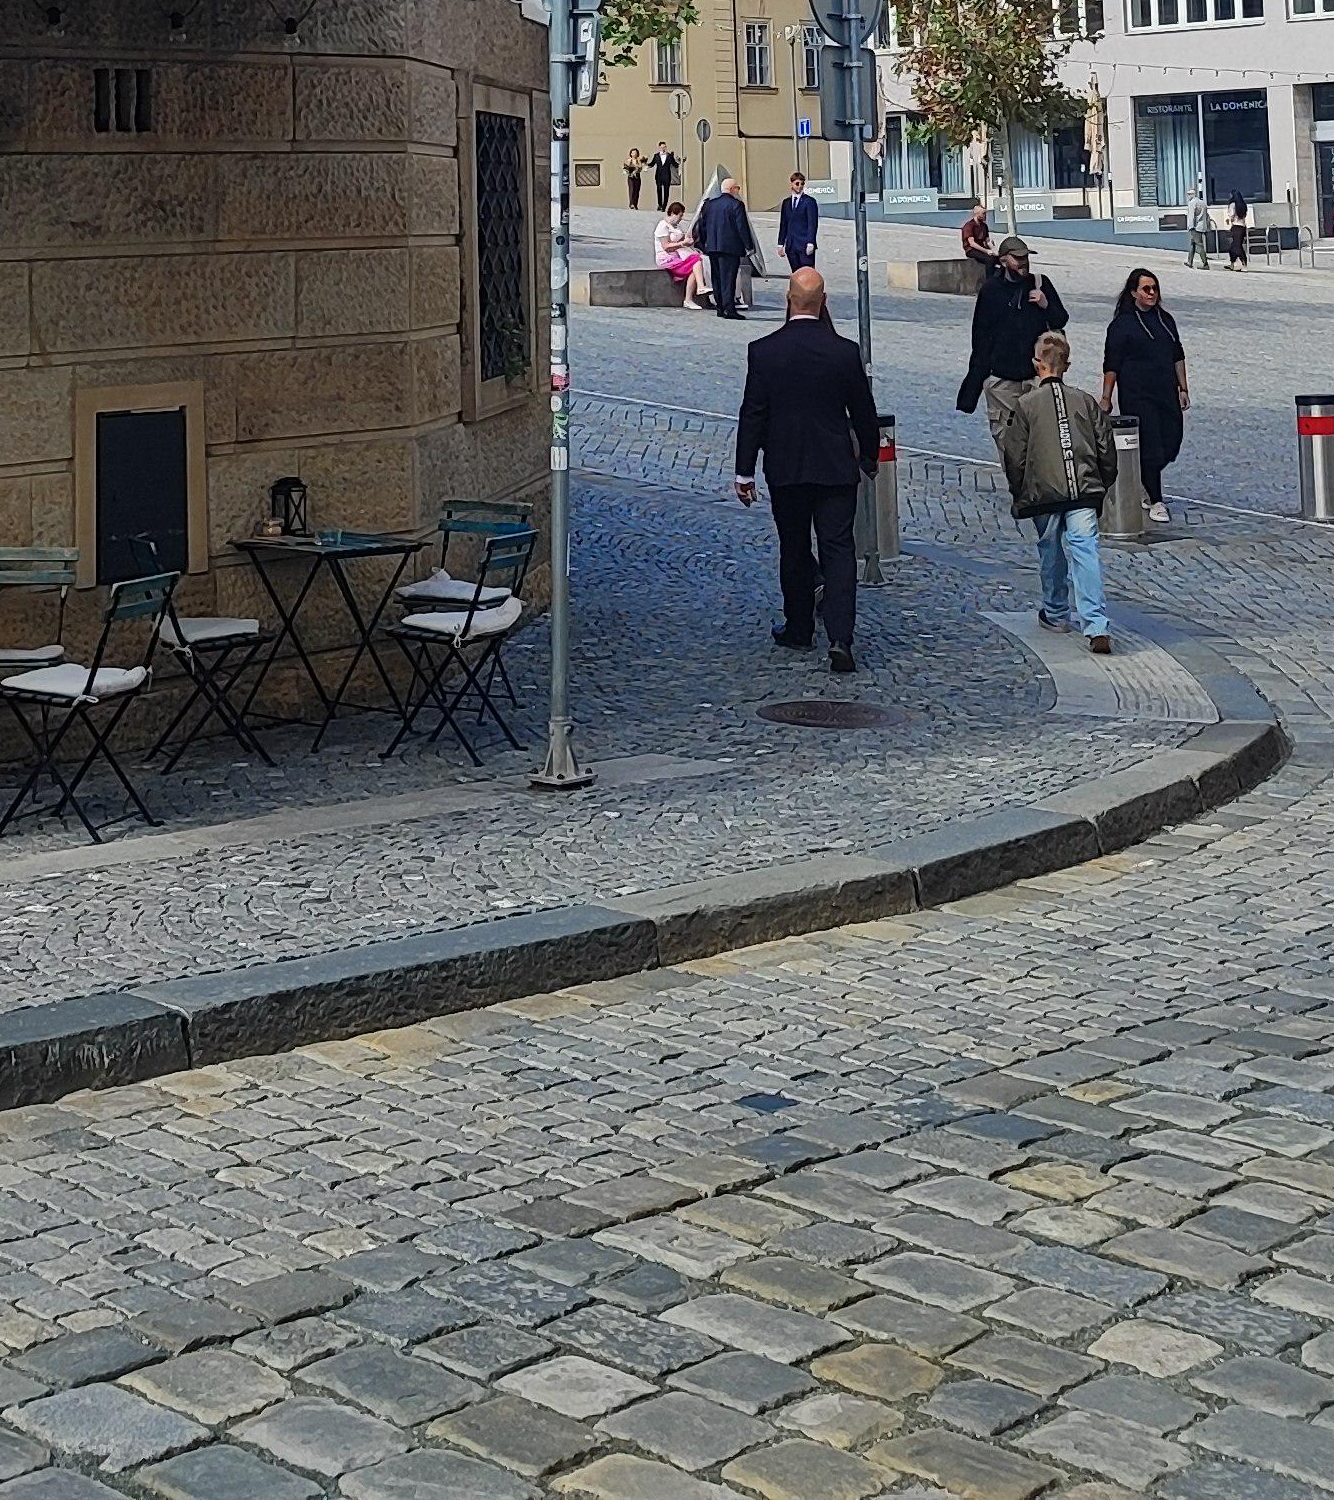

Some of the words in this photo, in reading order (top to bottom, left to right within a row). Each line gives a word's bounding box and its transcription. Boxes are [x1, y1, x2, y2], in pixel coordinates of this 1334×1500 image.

[1147, 104, 1193, 114] RISTORANTE
[1210, 102, 1222, 111] LA
[1014, 203, 1045, 211] OMENICA
